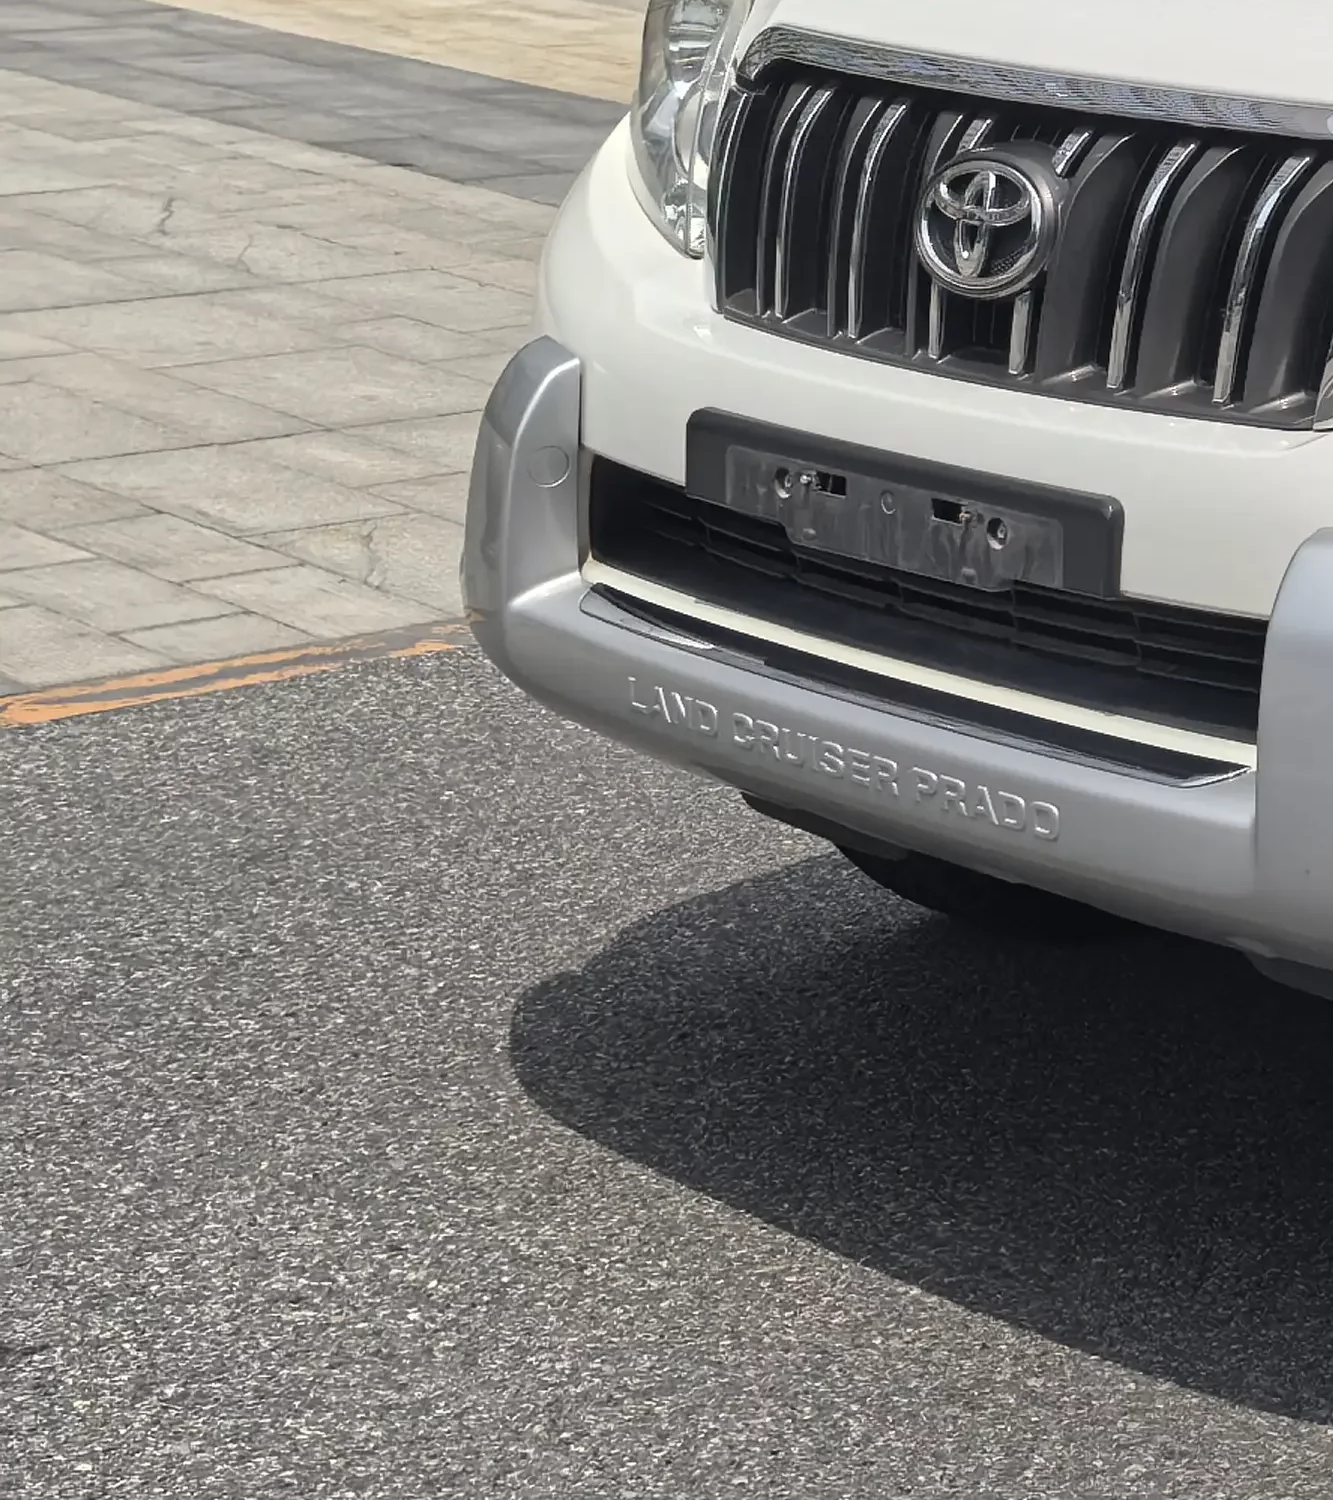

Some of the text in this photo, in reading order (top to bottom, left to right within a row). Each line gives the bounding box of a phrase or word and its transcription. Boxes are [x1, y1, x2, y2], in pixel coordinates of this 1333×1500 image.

[627, 676, 1061, 842] LAND CRUISER PRADO
